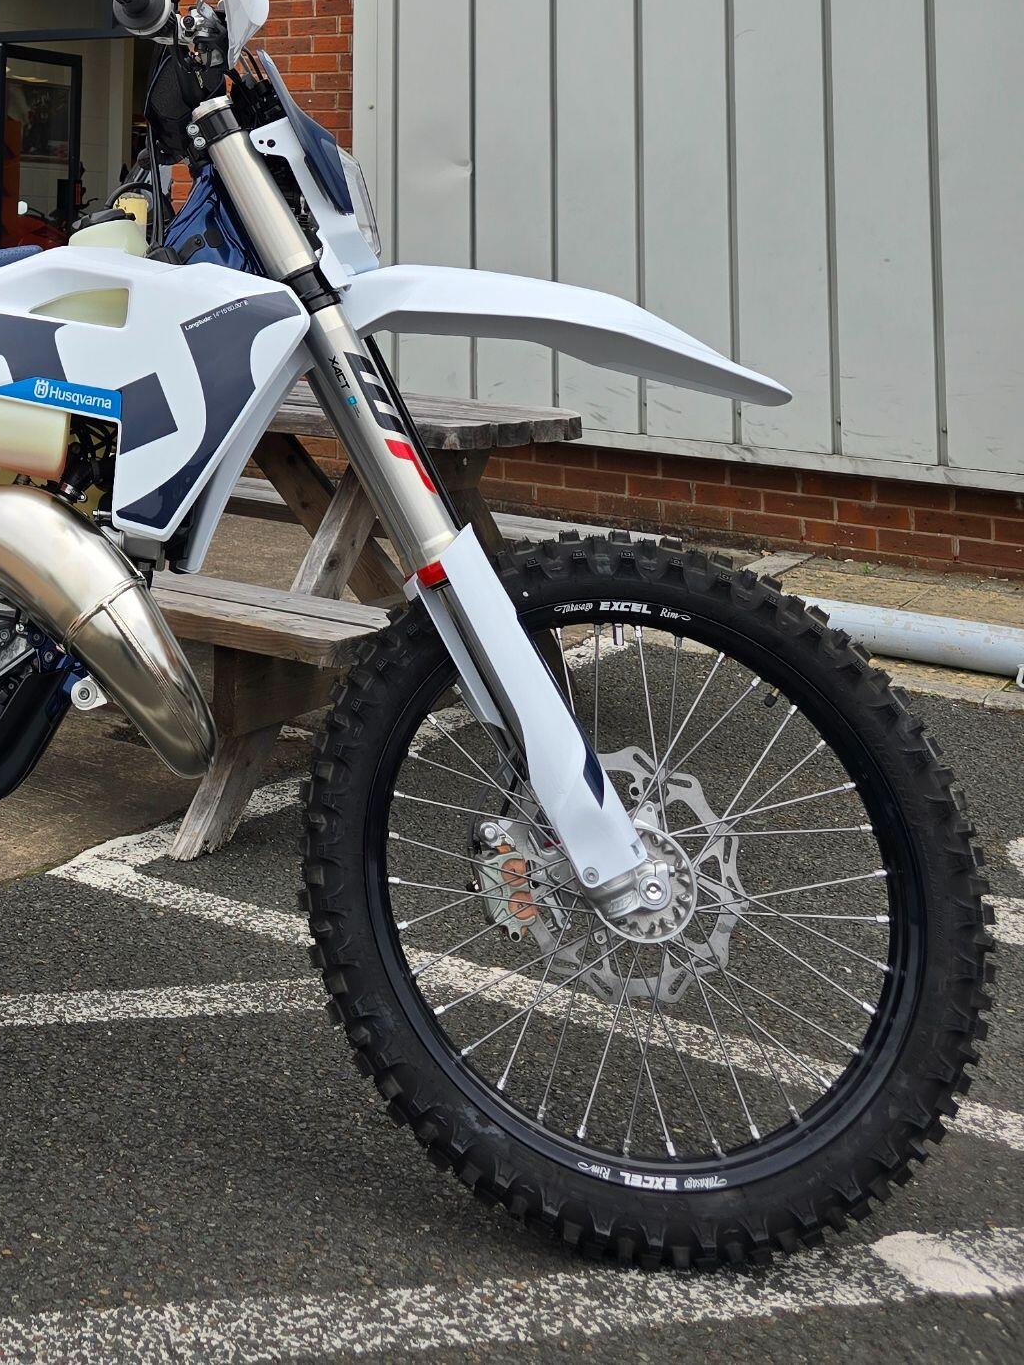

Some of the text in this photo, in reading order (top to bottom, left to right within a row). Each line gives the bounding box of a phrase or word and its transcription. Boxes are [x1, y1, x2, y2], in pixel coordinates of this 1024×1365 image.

[328, 355, 351, 389] XACT
[48, 385, 112, 410] Husqvarna
[553, 601, 691, 621] Takasago EXCEL Rim
[577, 1161, 611, 1180] Rim
[619, 1171, 678, 1191] EXCEL
